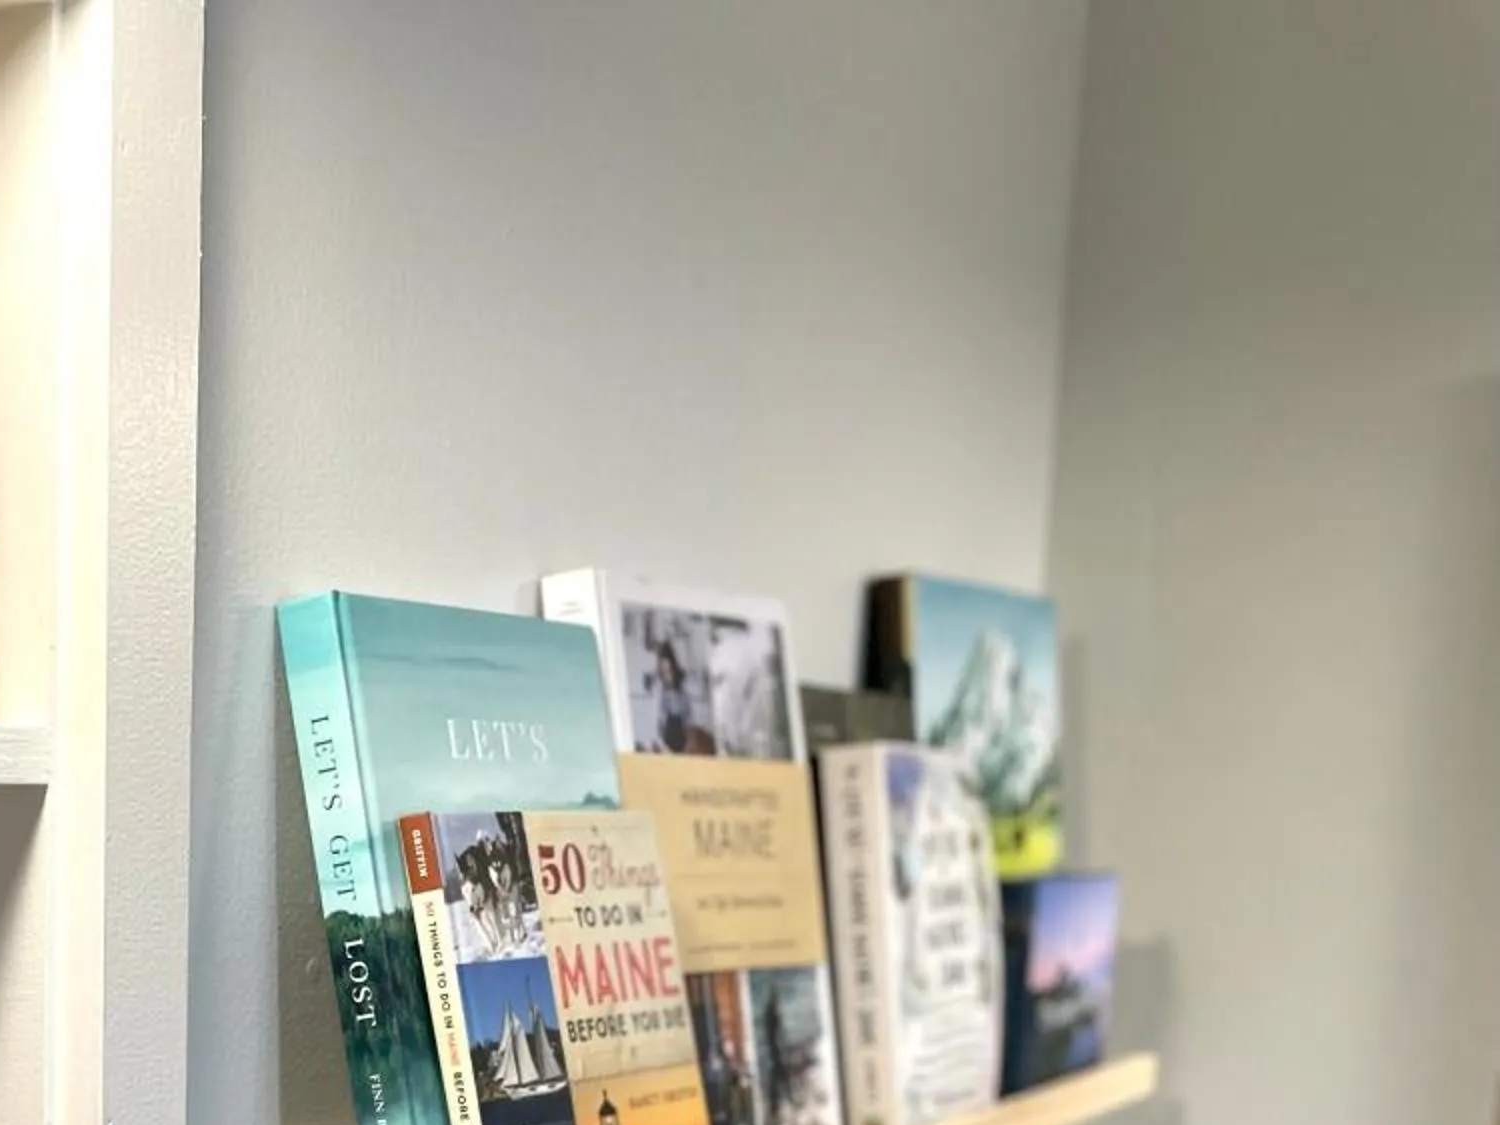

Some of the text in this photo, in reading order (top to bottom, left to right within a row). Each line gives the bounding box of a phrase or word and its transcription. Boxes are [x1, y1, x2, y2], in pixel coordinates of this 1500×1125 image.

[447, 719, 550, 763] LET'S
[311, 716, 376, 1027] LET'S GET LOST
[538, 843, 586, 895] 50
[574, 904, 643, 928] TO DO IN
[427, 922, 443, 967] THINGS
[437, 973, 447, 988] TO
[555, 937, 681, 1010] MAINE
[440, 994, 451, 1012] DO
[444, 1016, 454, 1029] IN
[566, 1006, 686, 1043] BEFORE YOU DIE
[370, 1073, 385, 1112] FINN
[454, 1071, 469, 1120] BEFORE
